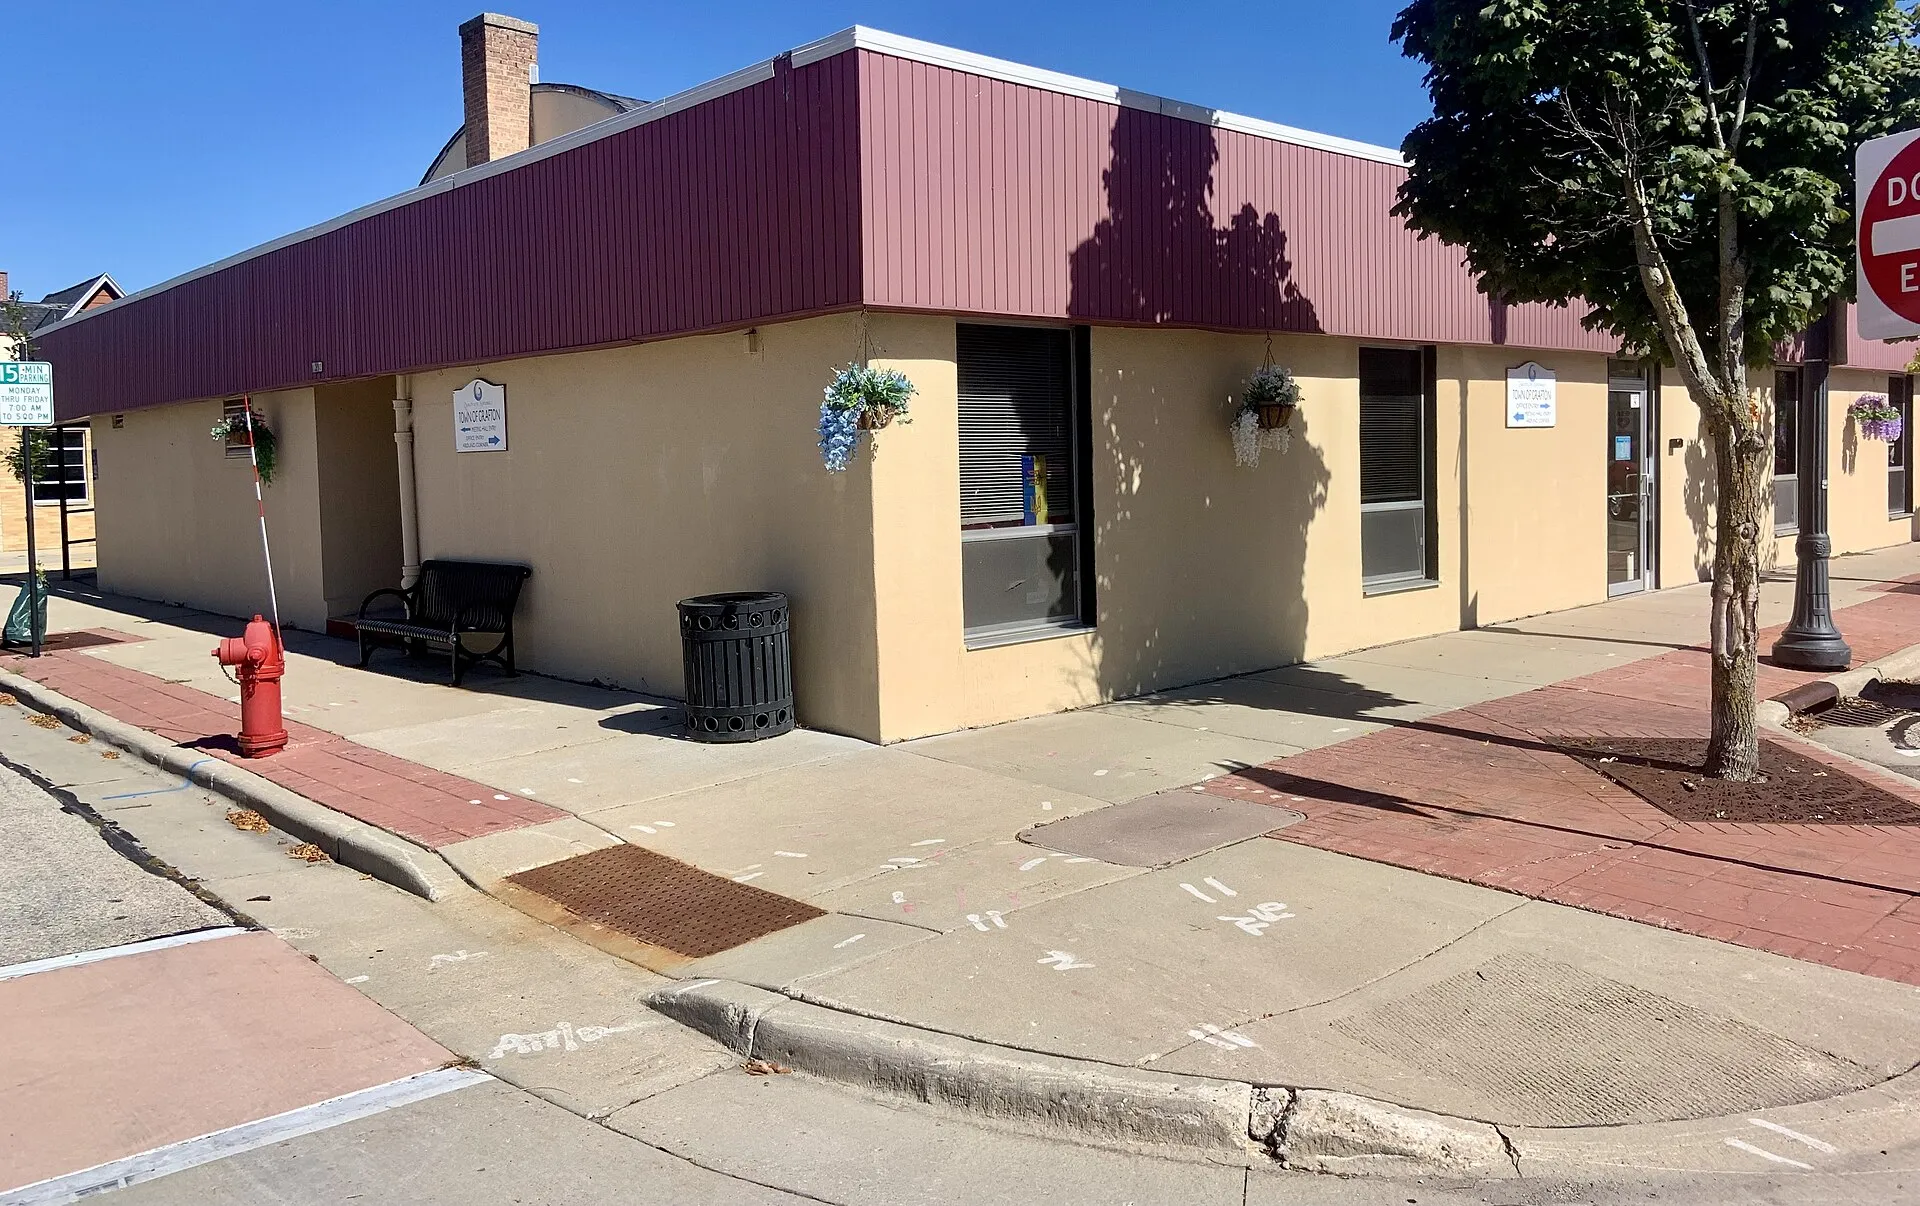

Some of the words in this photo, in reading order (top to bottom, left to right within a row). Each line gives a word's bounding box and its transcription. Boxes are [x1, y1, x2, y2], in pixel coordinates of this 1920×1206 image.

[20, 374, 49, 383] PARKING
[1512, 389, 1525, 400] TOWN
[1532, 389, 1552, 400] GRAFTON
[1, 395, 20, 403] THRU
[24, 395, 49, 403] FRIDAY
[31, 404, 42, 412] AM
[3, 413, 12, 421] TO
[458, 411, 472, 424] TOWN
[479, 408, 501, 422] GRAFTON
